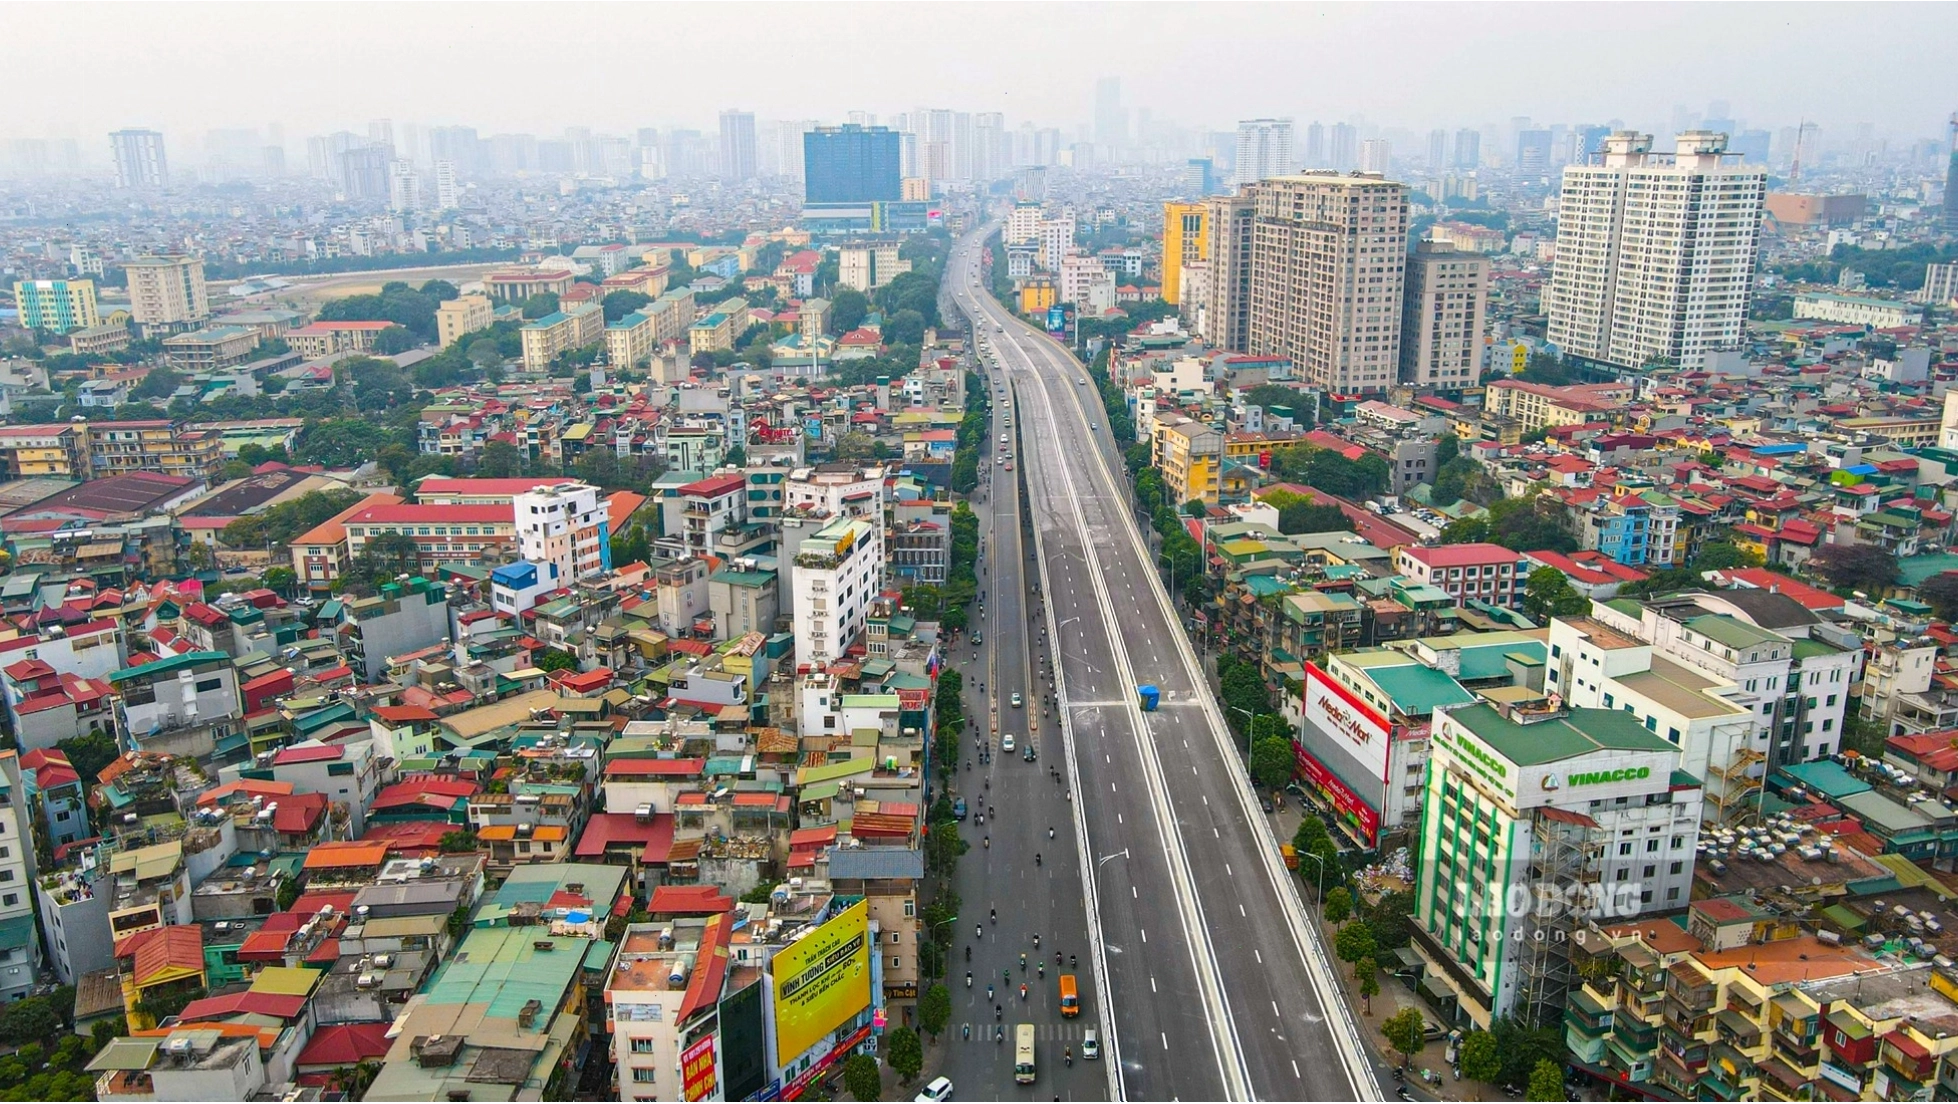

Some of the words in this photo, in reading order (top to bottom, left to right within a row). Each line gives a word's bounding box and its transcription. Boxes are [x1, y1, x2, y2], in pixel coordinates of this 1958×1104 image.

[1318, 695, 1343, 722] Media
[1349, 720, 1370, 745] Mart
[1456, 733, 1507, 778] VINACCO
[1568, 766, 1650, 787] VINACCO
